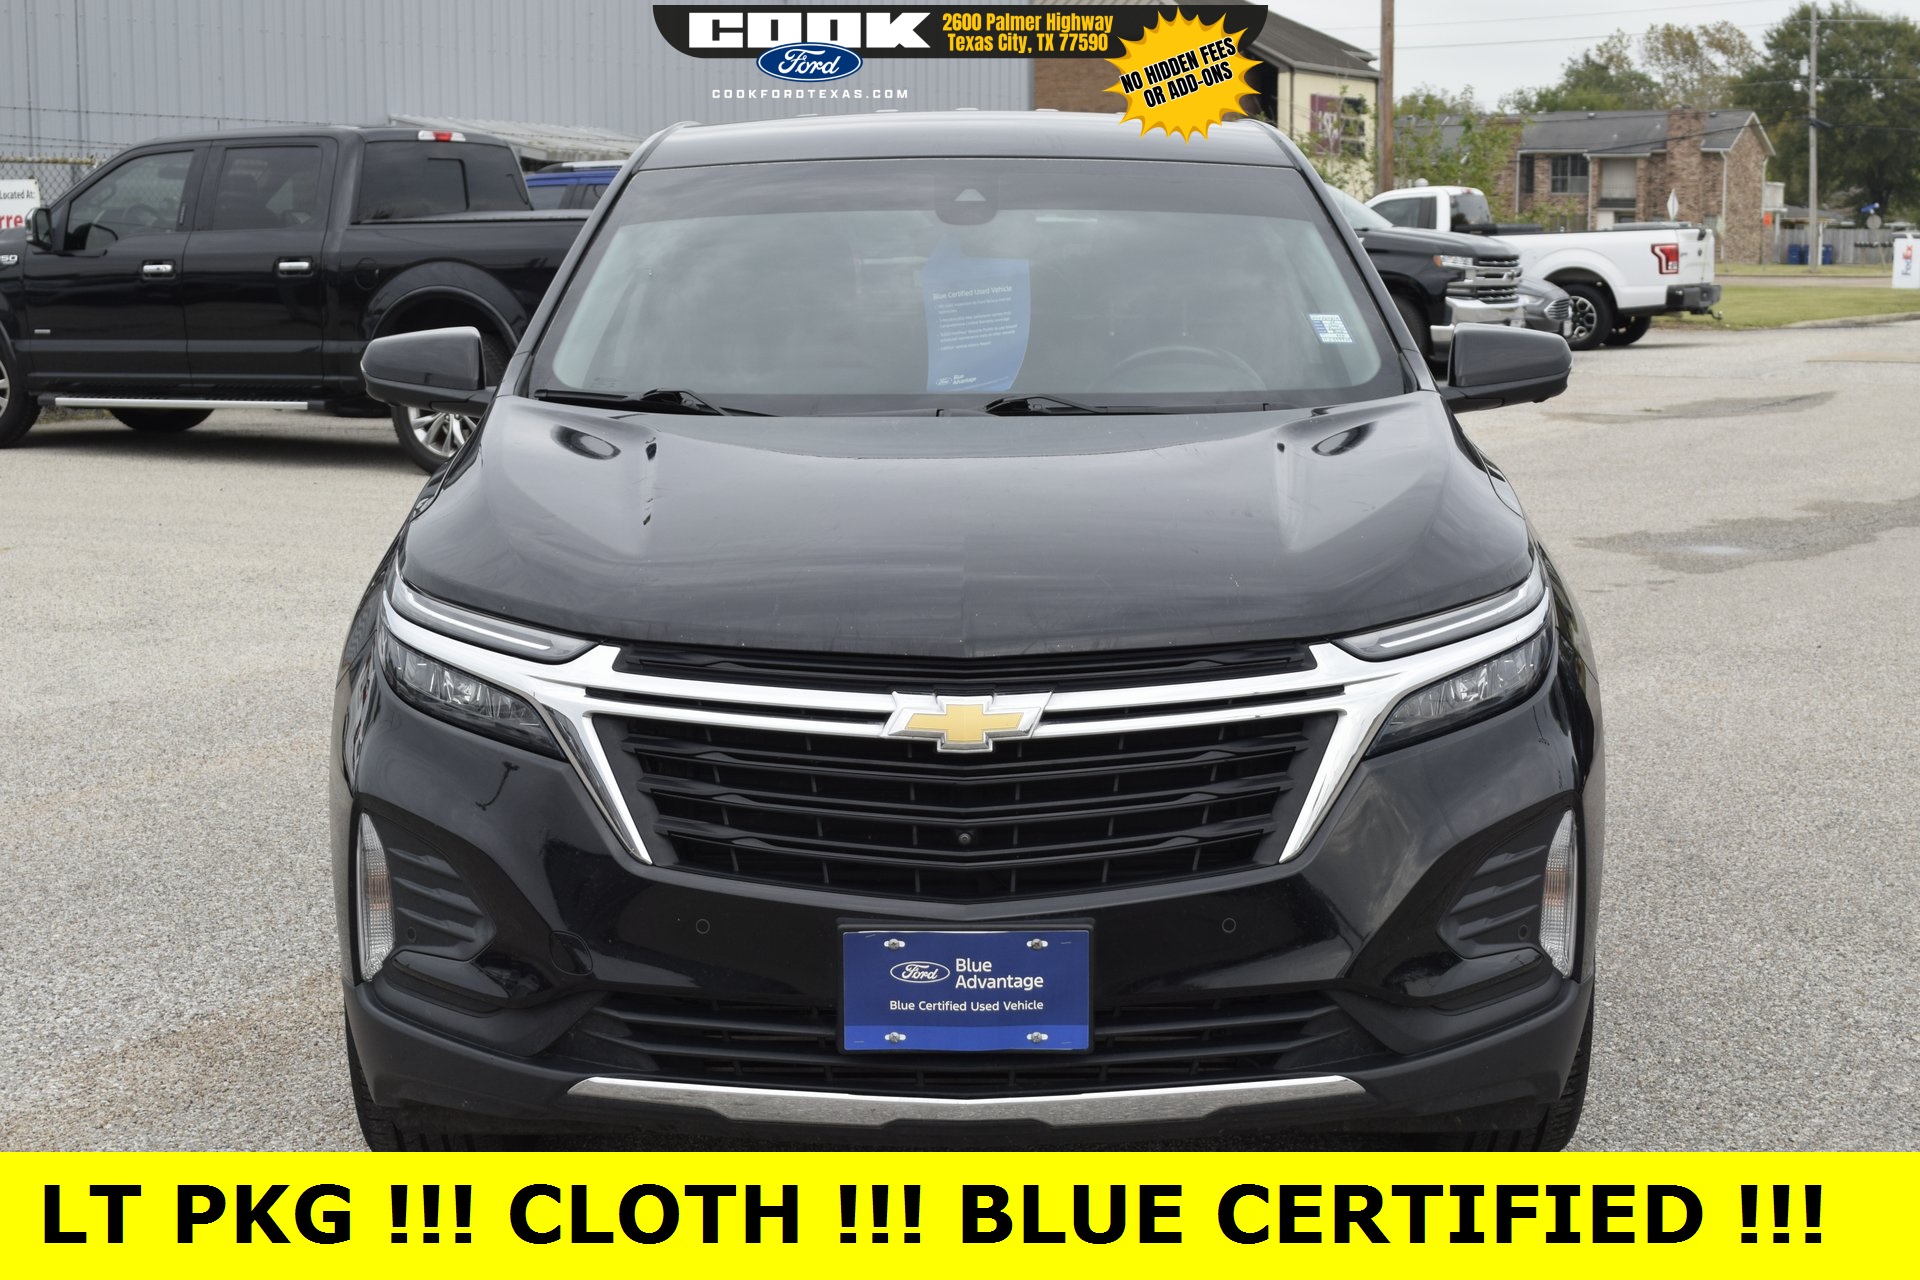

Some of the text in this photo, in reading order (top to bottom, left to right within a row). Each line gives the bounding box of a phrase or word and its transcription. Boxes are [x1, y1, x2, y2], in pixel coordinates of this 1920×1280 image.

[949, 289, 974, 299] Certified
[901, 963, 940, 981] Ford
[955, 958, 993, 973] Blue
[955, 974, 1044, 991] Advantage
[889, 1000, 1044, 1012] Blue Certified Used Vehicle
